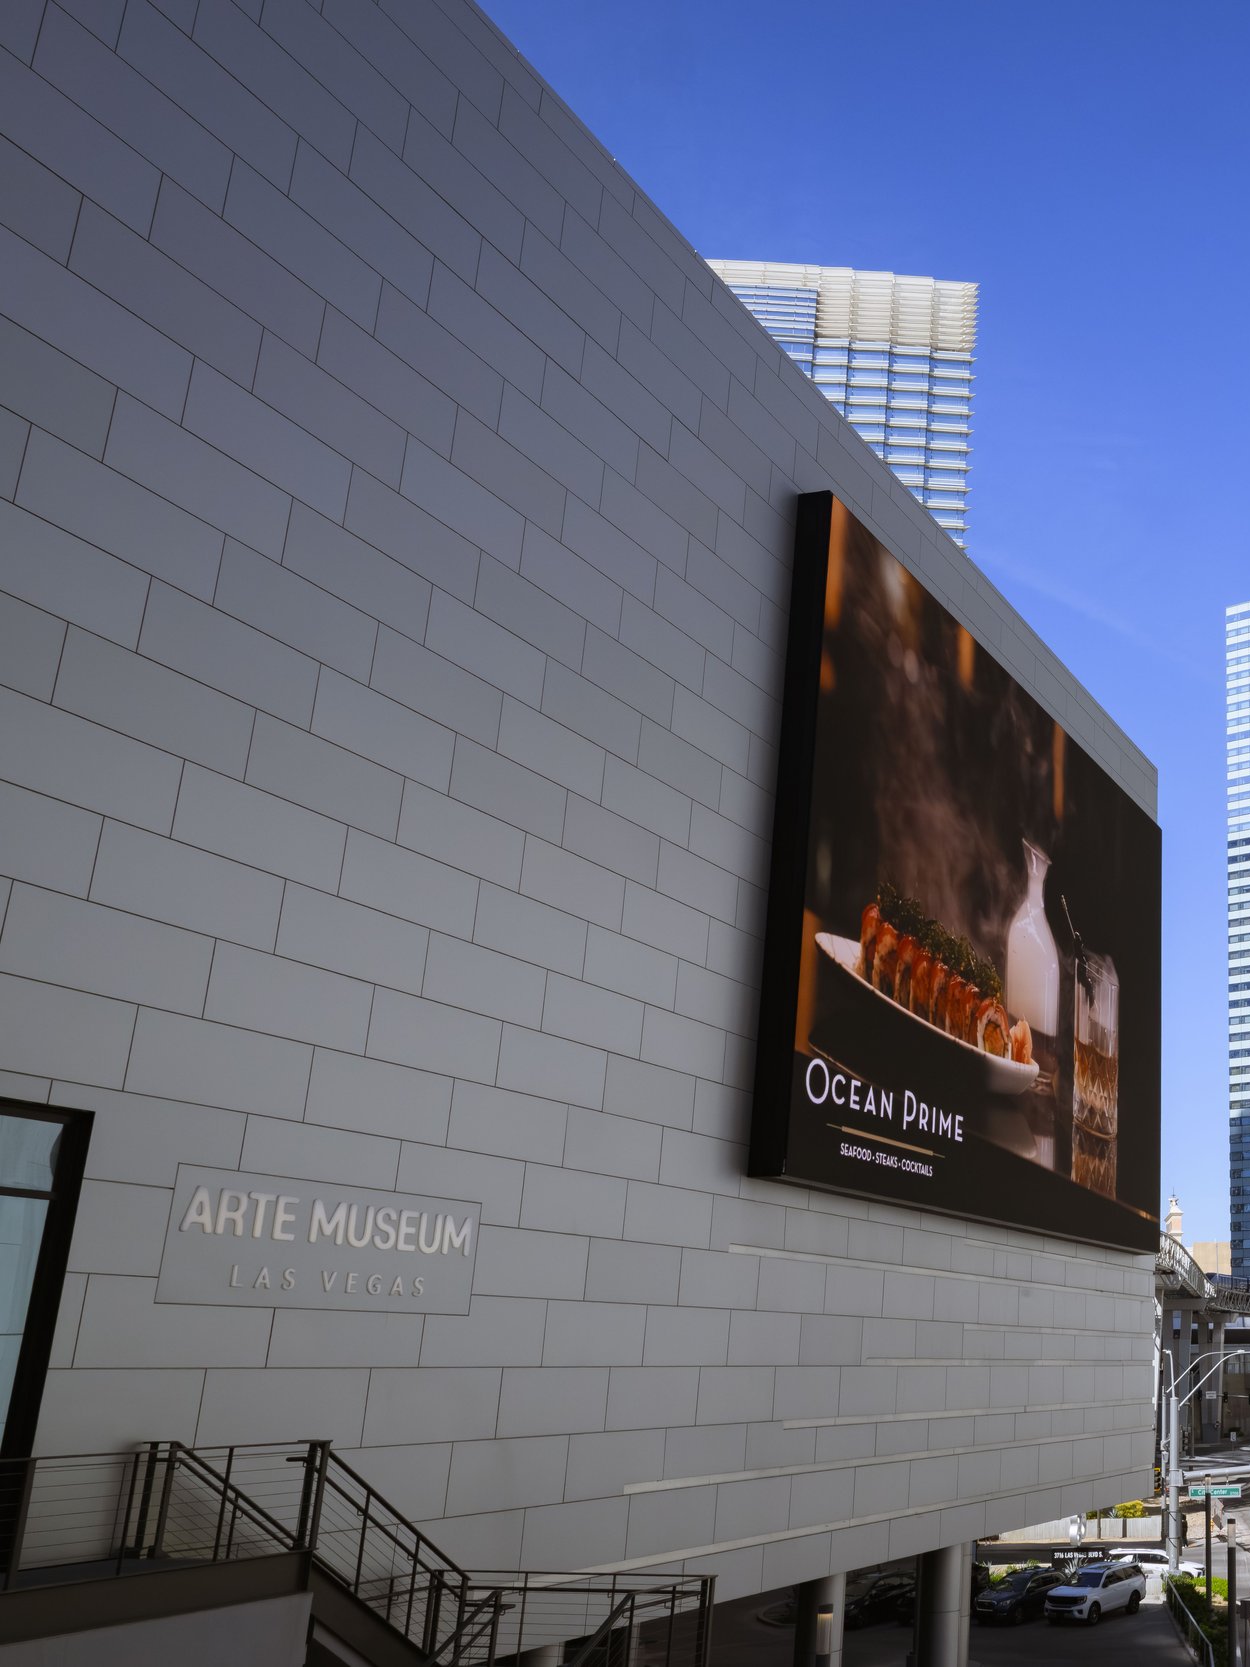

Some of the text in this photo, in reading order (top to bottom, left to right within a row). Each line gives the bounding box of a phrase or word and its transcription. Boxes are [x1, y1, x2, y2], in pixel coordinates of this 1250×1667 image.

[806, 1058, 964, 1142] OCEAN PRIME
[840, 1142, 933, 1177] SEAFOOD STEAKS COCKTAILS
[179, 1185, 473, 1257] ARTE MUSEUM
[229, 1264, 425, 1297] LAS VEGAS
